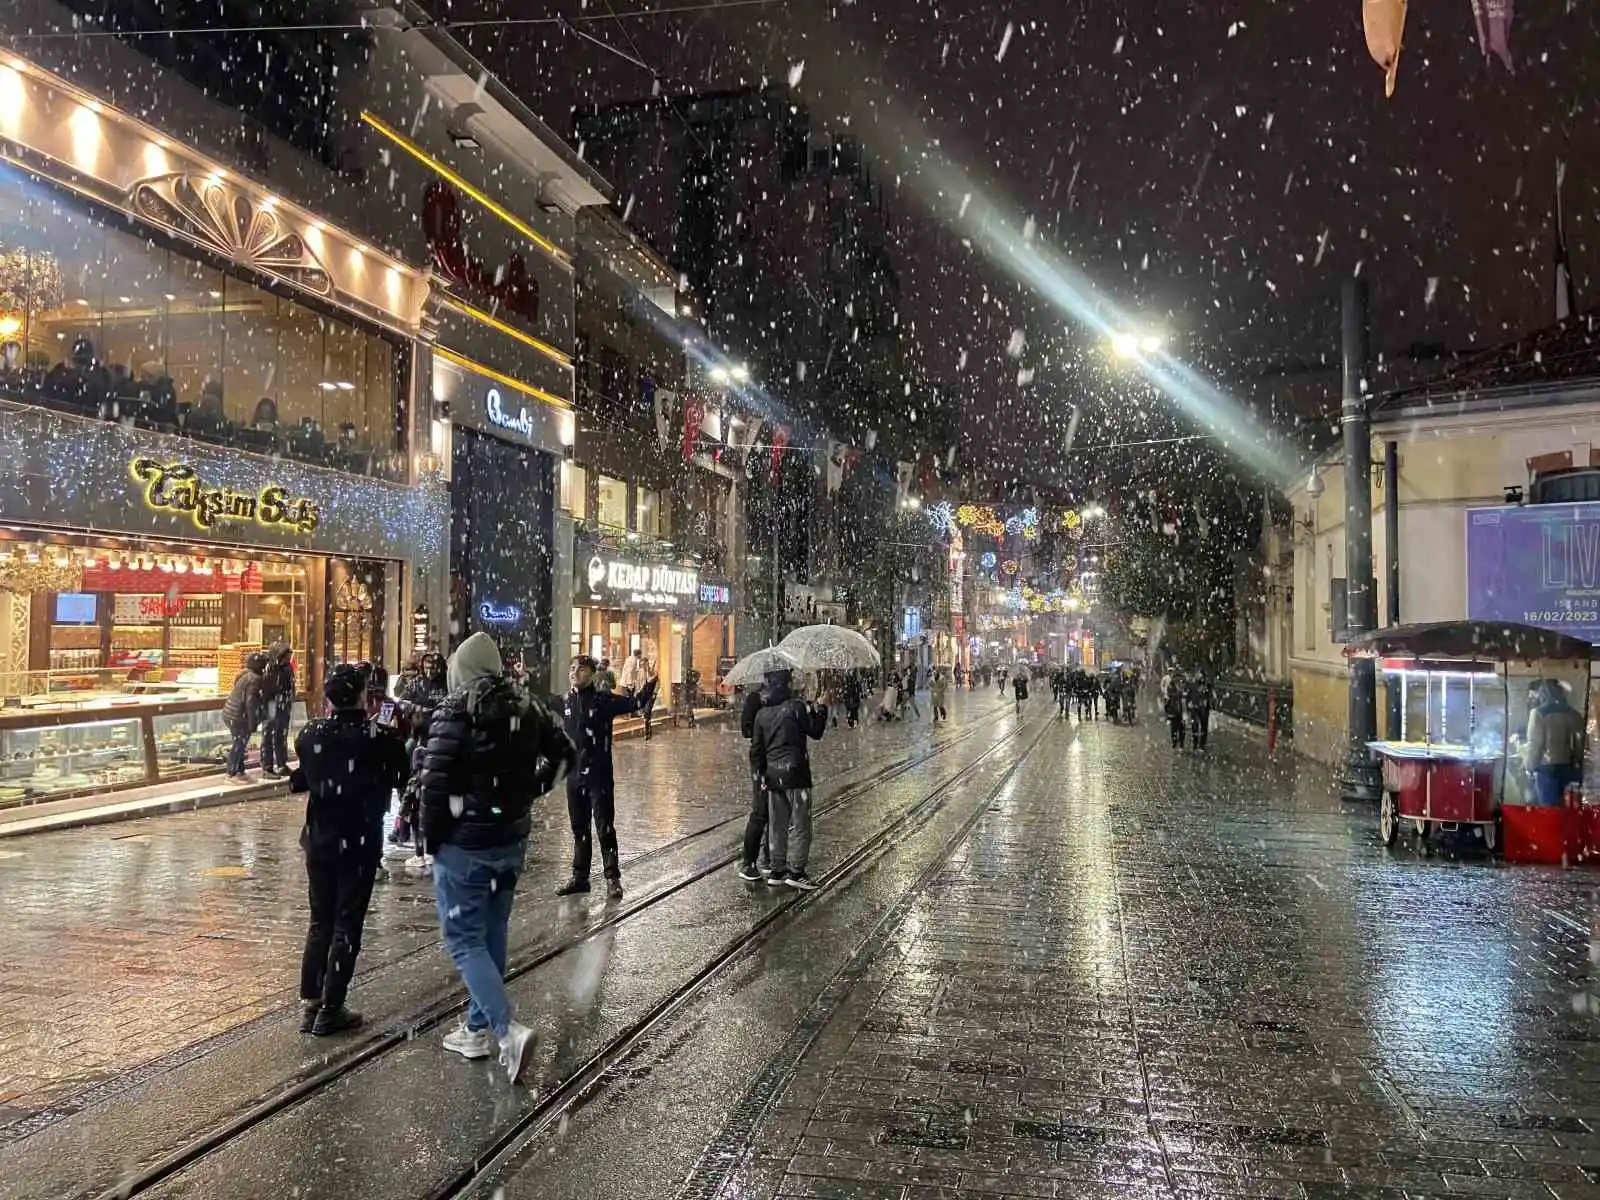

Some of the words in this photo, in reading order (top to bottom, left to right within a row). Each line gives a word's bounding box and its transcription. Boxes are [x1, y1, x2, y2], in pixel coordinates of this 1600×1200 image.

[487, 388, 533, 442] Bambi
[131, 458, 256, 528] Taksim
[607, 561, 650, 590] KEBAP
[480, 602, 519, 622] Bambi
[1523, 610, 1598, 621] 16/02/2023
